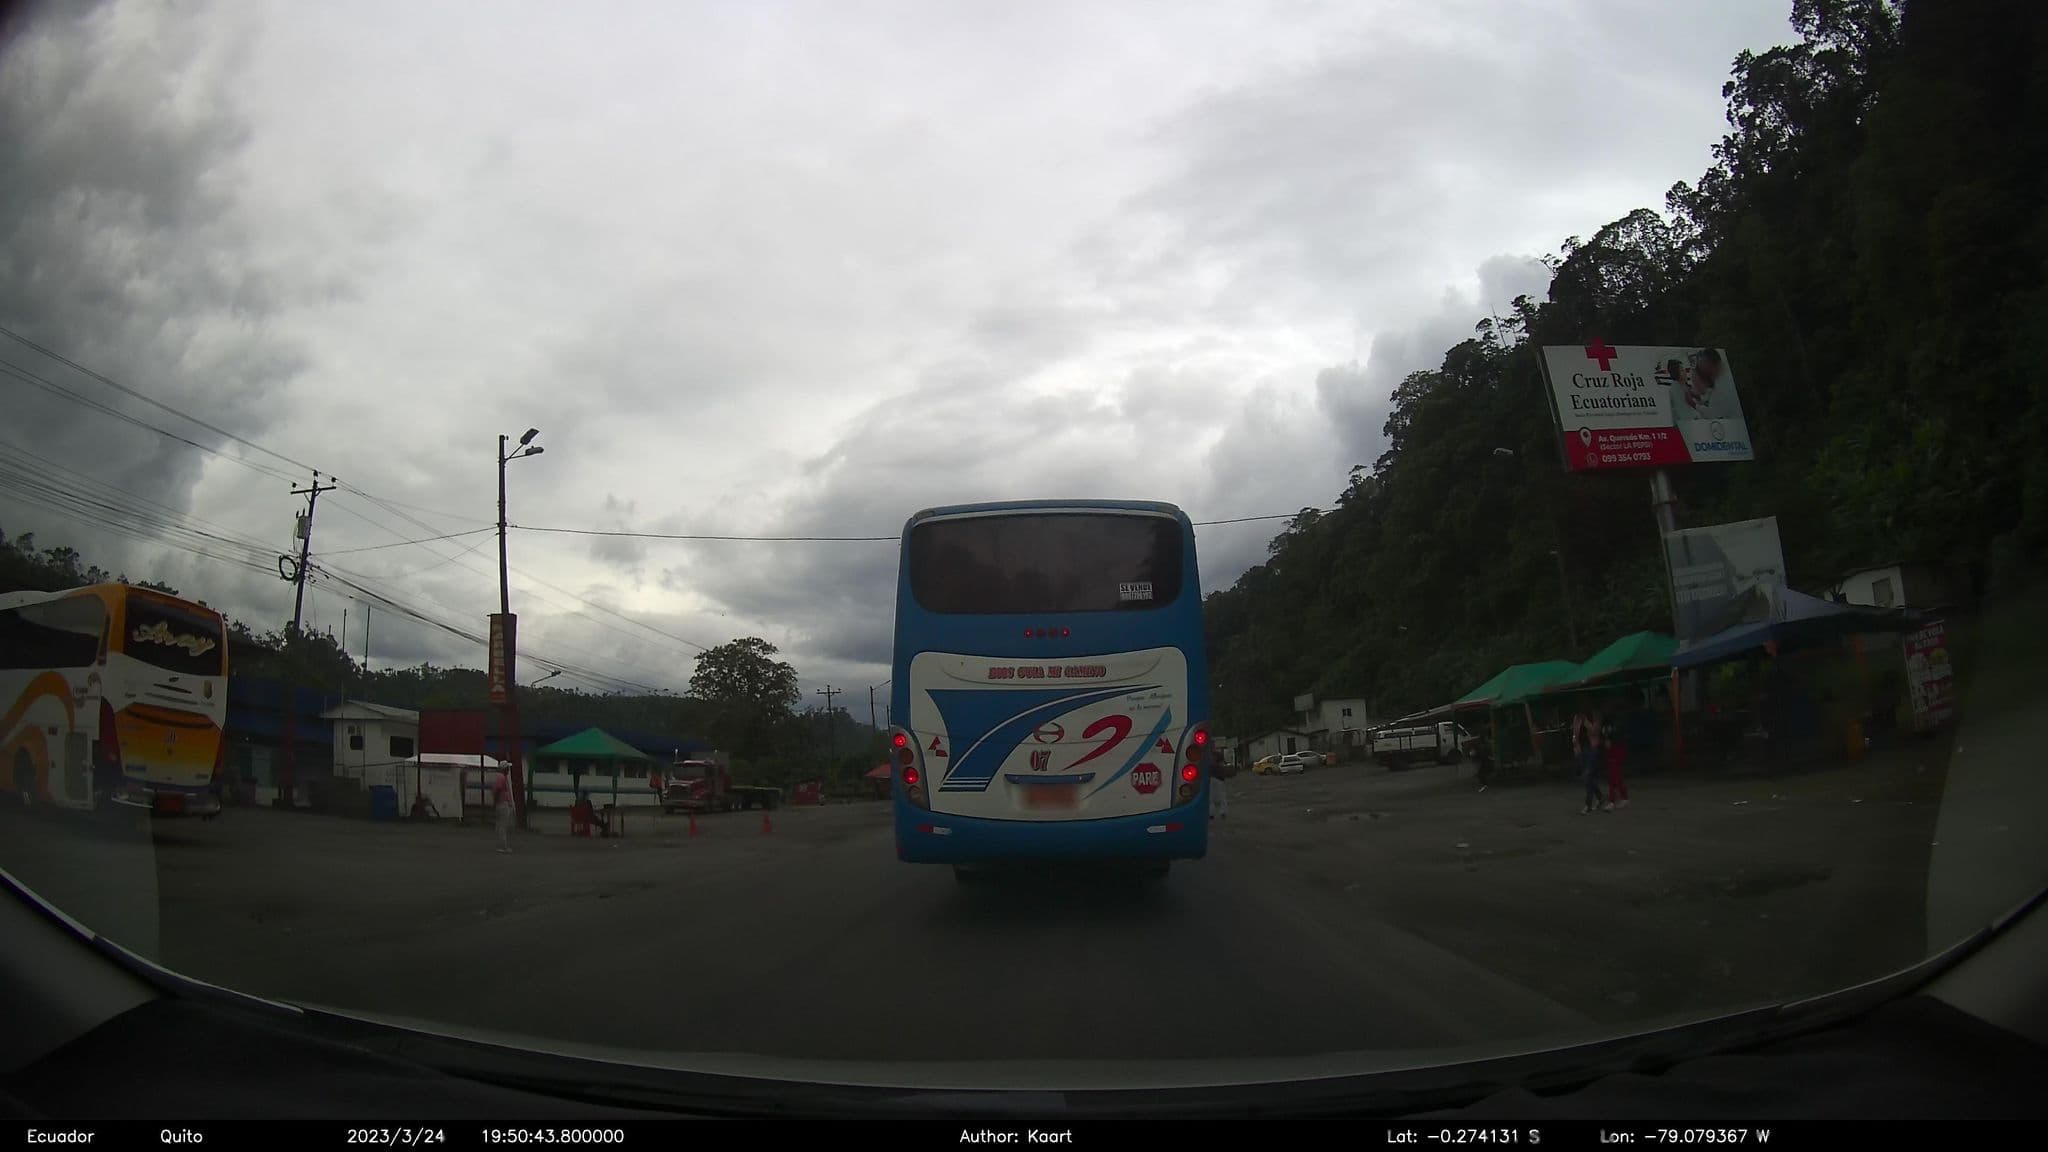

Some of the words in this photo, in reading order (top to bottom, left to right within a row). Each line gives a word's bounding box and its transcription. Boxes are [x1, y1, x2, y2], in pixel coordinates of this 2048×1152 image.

[1572, 373, 1609, 389] Cruz
[1611, 373, 1645, 391] Roja
[1570, 393, 1656, 410] Ecuatoriana
[1694, 440, 1749, 452] DOMIDENTAL
[1602, 454, 1617, 463] 099
[1618, 453, 1633, 463] 354
[1030, 750, 1051, 771] 07
[1132, 771, 1159, 787] PARE
